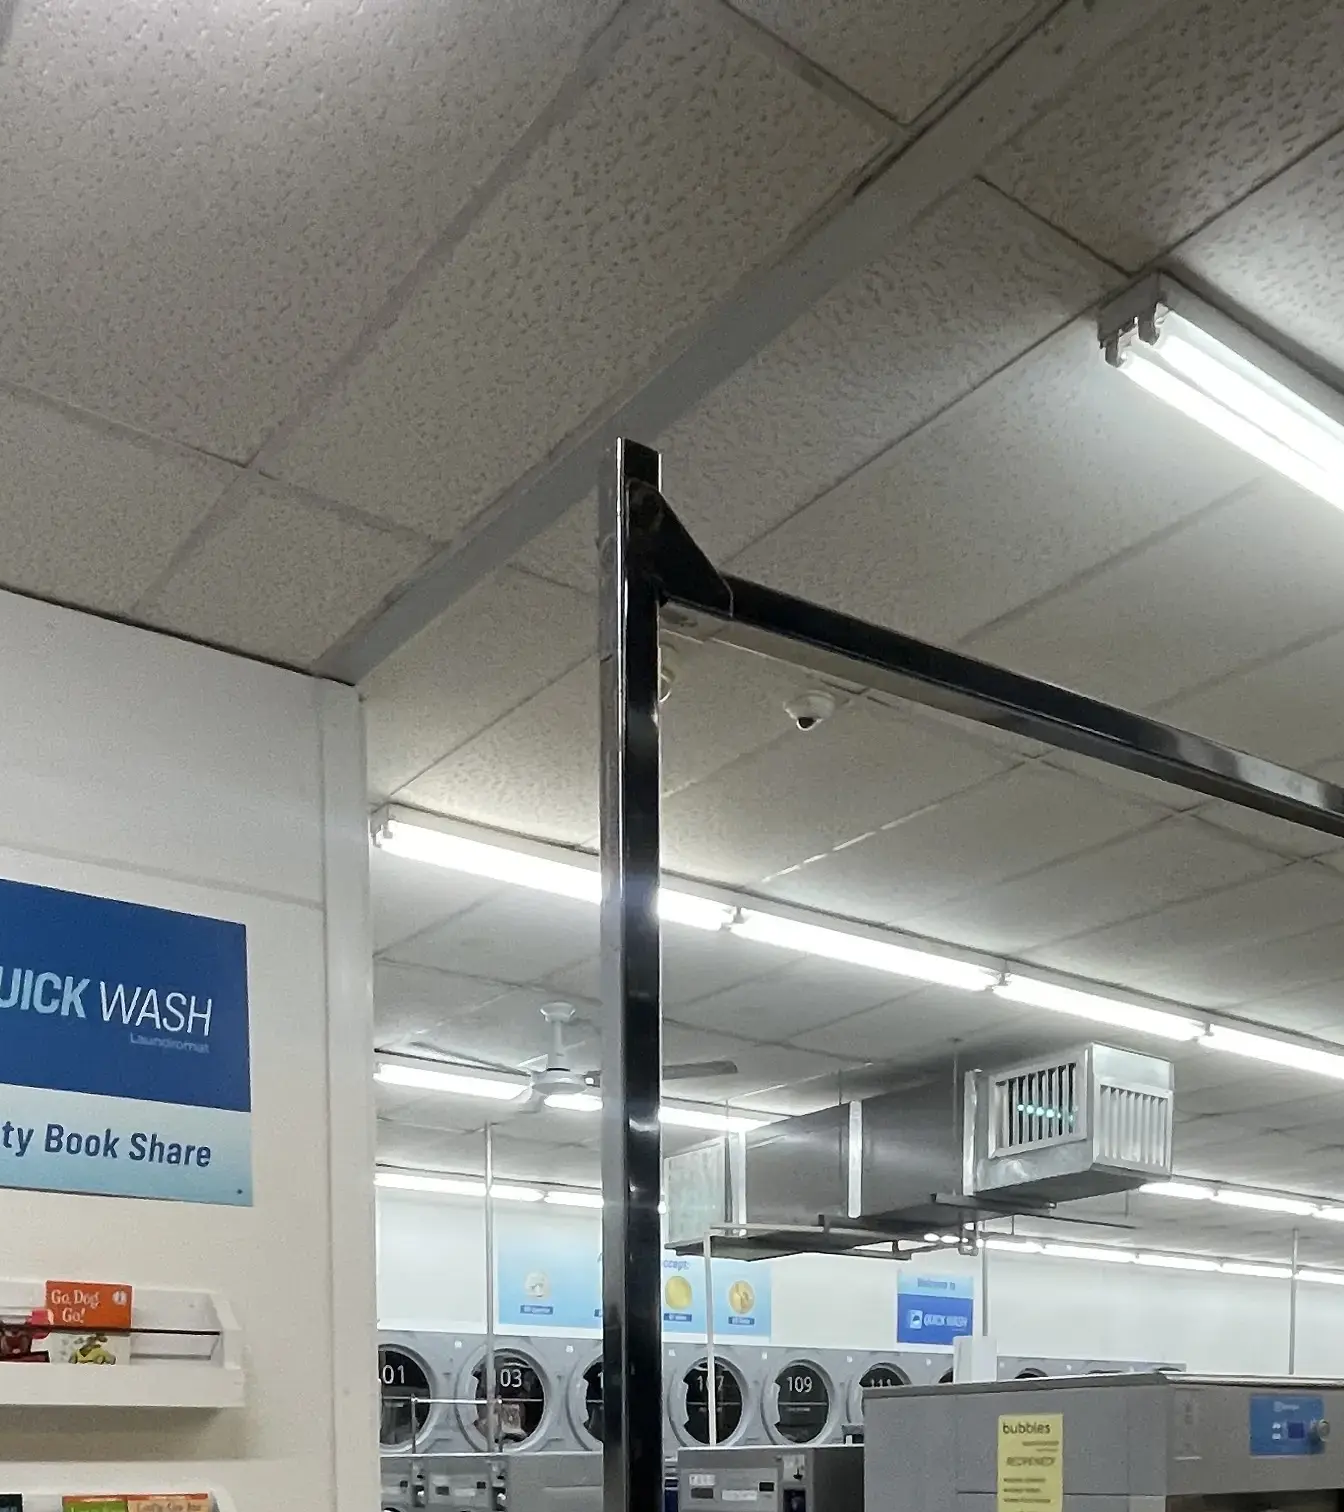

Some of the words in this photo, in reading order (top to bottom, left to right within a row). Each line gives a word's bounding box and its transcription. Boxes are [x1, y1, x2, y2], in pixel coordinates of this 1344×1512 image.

[99, 981, 212, 1036] WASH
[44, 1124, 119, 1159] Book
[128, 1133, 211, 1167] Share
[62, 1307, 86, 1323] Go!
[382, 1364, 405, 1385] 01
[500, 1369, 522, 1388] 03
[697, 1376, 724, 1392] 17
[786, 1376, 813, 1393] 109
[1002, 1422, 1051, 1434] bubbles
